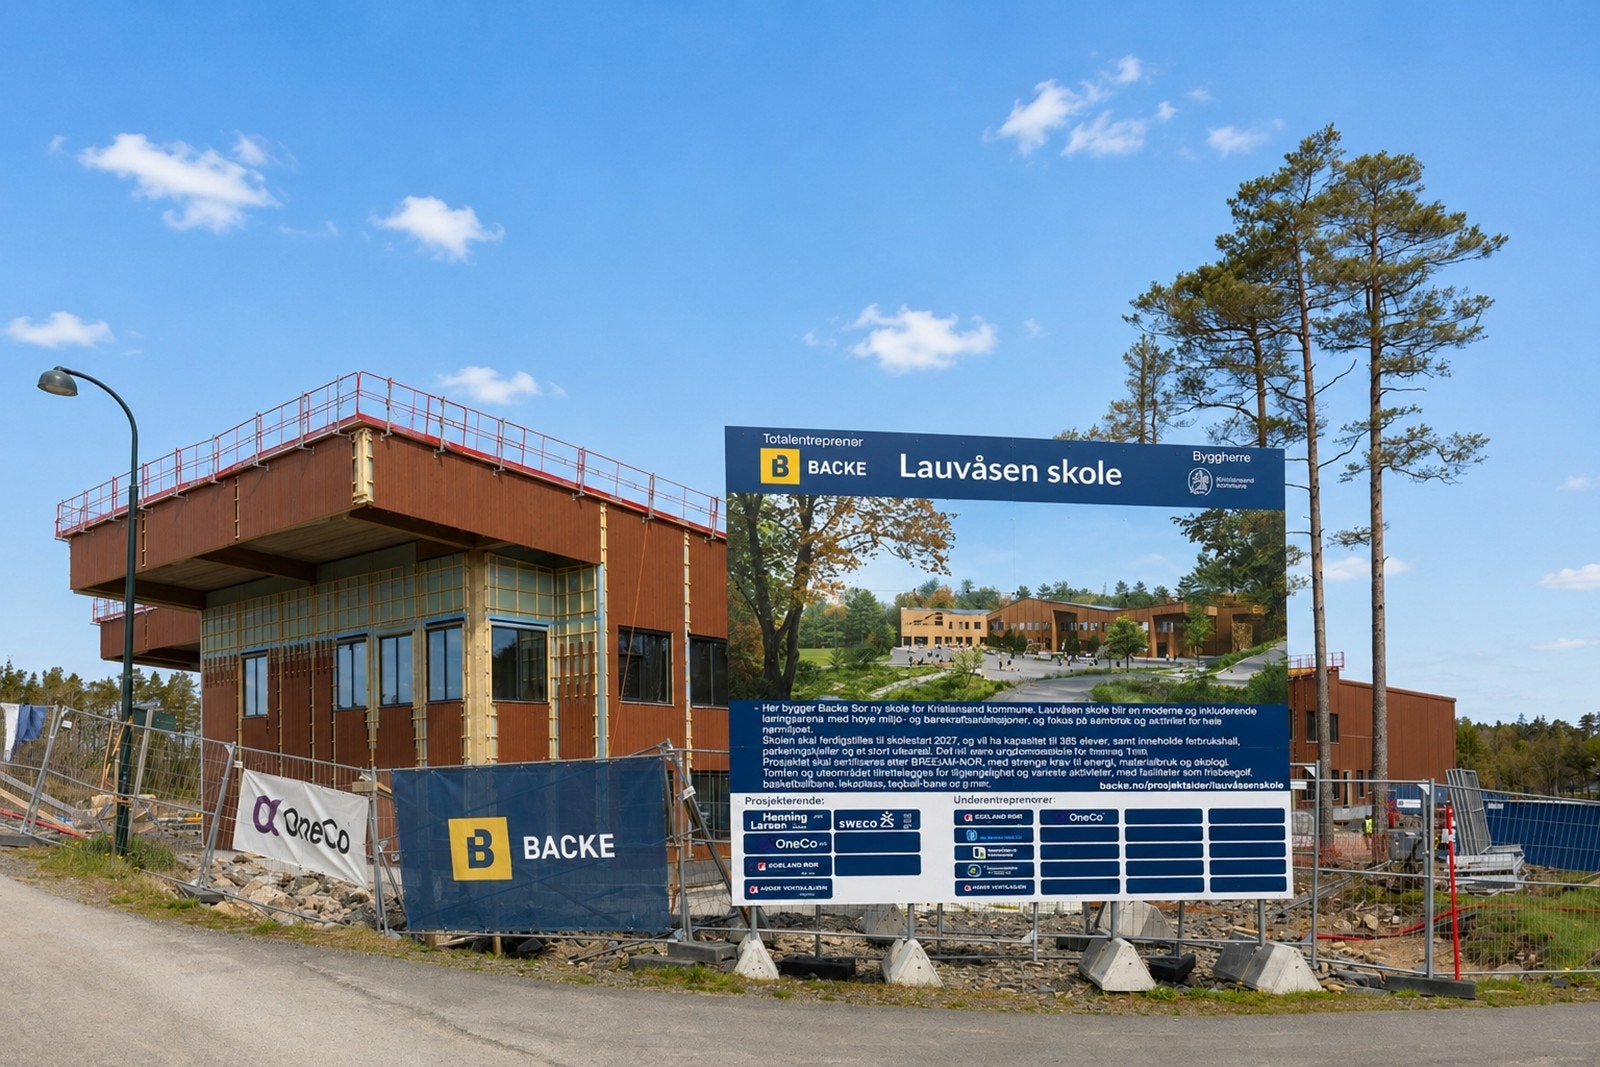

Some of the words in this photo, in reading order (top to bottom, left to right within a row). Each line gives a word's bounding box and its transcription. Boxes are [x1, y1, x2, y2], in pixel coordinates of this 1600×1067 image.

[1193, 451, 1250, 464] Byggherre
[808, 460, 866, 475] BACKE
[900, 453, 1038, 482] Lauvåsen
[1048, 459, 1122, 486] skole
[762, 704, 779, 713] Her
[782, 704, 816, 715] bygger
[818, 704, 848, 714] Backe
[870, 707, 882, 715] ny
[885, 705, 909, 714] skole
[912, 705, 925, 714] for
[987, 705, 1036, 715] kommune.
[1085, 706, 1109, 715] skole
[1112, 706, 1126, 715] blir
[1143, 706, 1183, 716] moderne
[1185, 708, 1197, 717] og
[1199, 707, 1257, 716] inkluderende
[828, 715, 849, 725] med
[909, 718, 921, 726] og
[1033, 718, 1045, 727] og
[1134, 719, 1146, 727] og
[1189, 717, 1200, 726] for
[763, 736, 795, 745] Skolen
[798, 736, 817, 745] skal
[876, 736, 884, 746] til
[887, 736, 932, 746] skolestart
[934, 737, 960, 747] 2027,
[962, 739, 974, 747] og
[977, 737, 987, 746] vil
[990, 737, 1001, 746] ha
[1049, 737, 1057, 746] til
[1113, 737, 1136, 746] samt
[1138, 737, 1183, 746] inneholde
[842, 749, 854, 758] og
[988, 758, 1009, 768] med
[1012, 758, 1047, 769] strenge
[1050, 758, 1070, 768] krav
[1180, 760, 1192, 769] og
[801, 770, 813, 779] og
[936, 768, 949, 778] for
[1017, 770, 1029, 779] og
[1116, 768, 1137, 778] med
[1183, 770, 1202, 778] som
[745, 796, 824, 806] Prosjekterende:
[763, 812, 808, 823] Henning
[1069, 813, 1104, 822] OneCo
[839, 820, 878, 828] SWECO
[283, 808, 350, 855] OneCo
[523, 833, 615, 860] BACKE
[775, 839, 818, 849] OneCo
